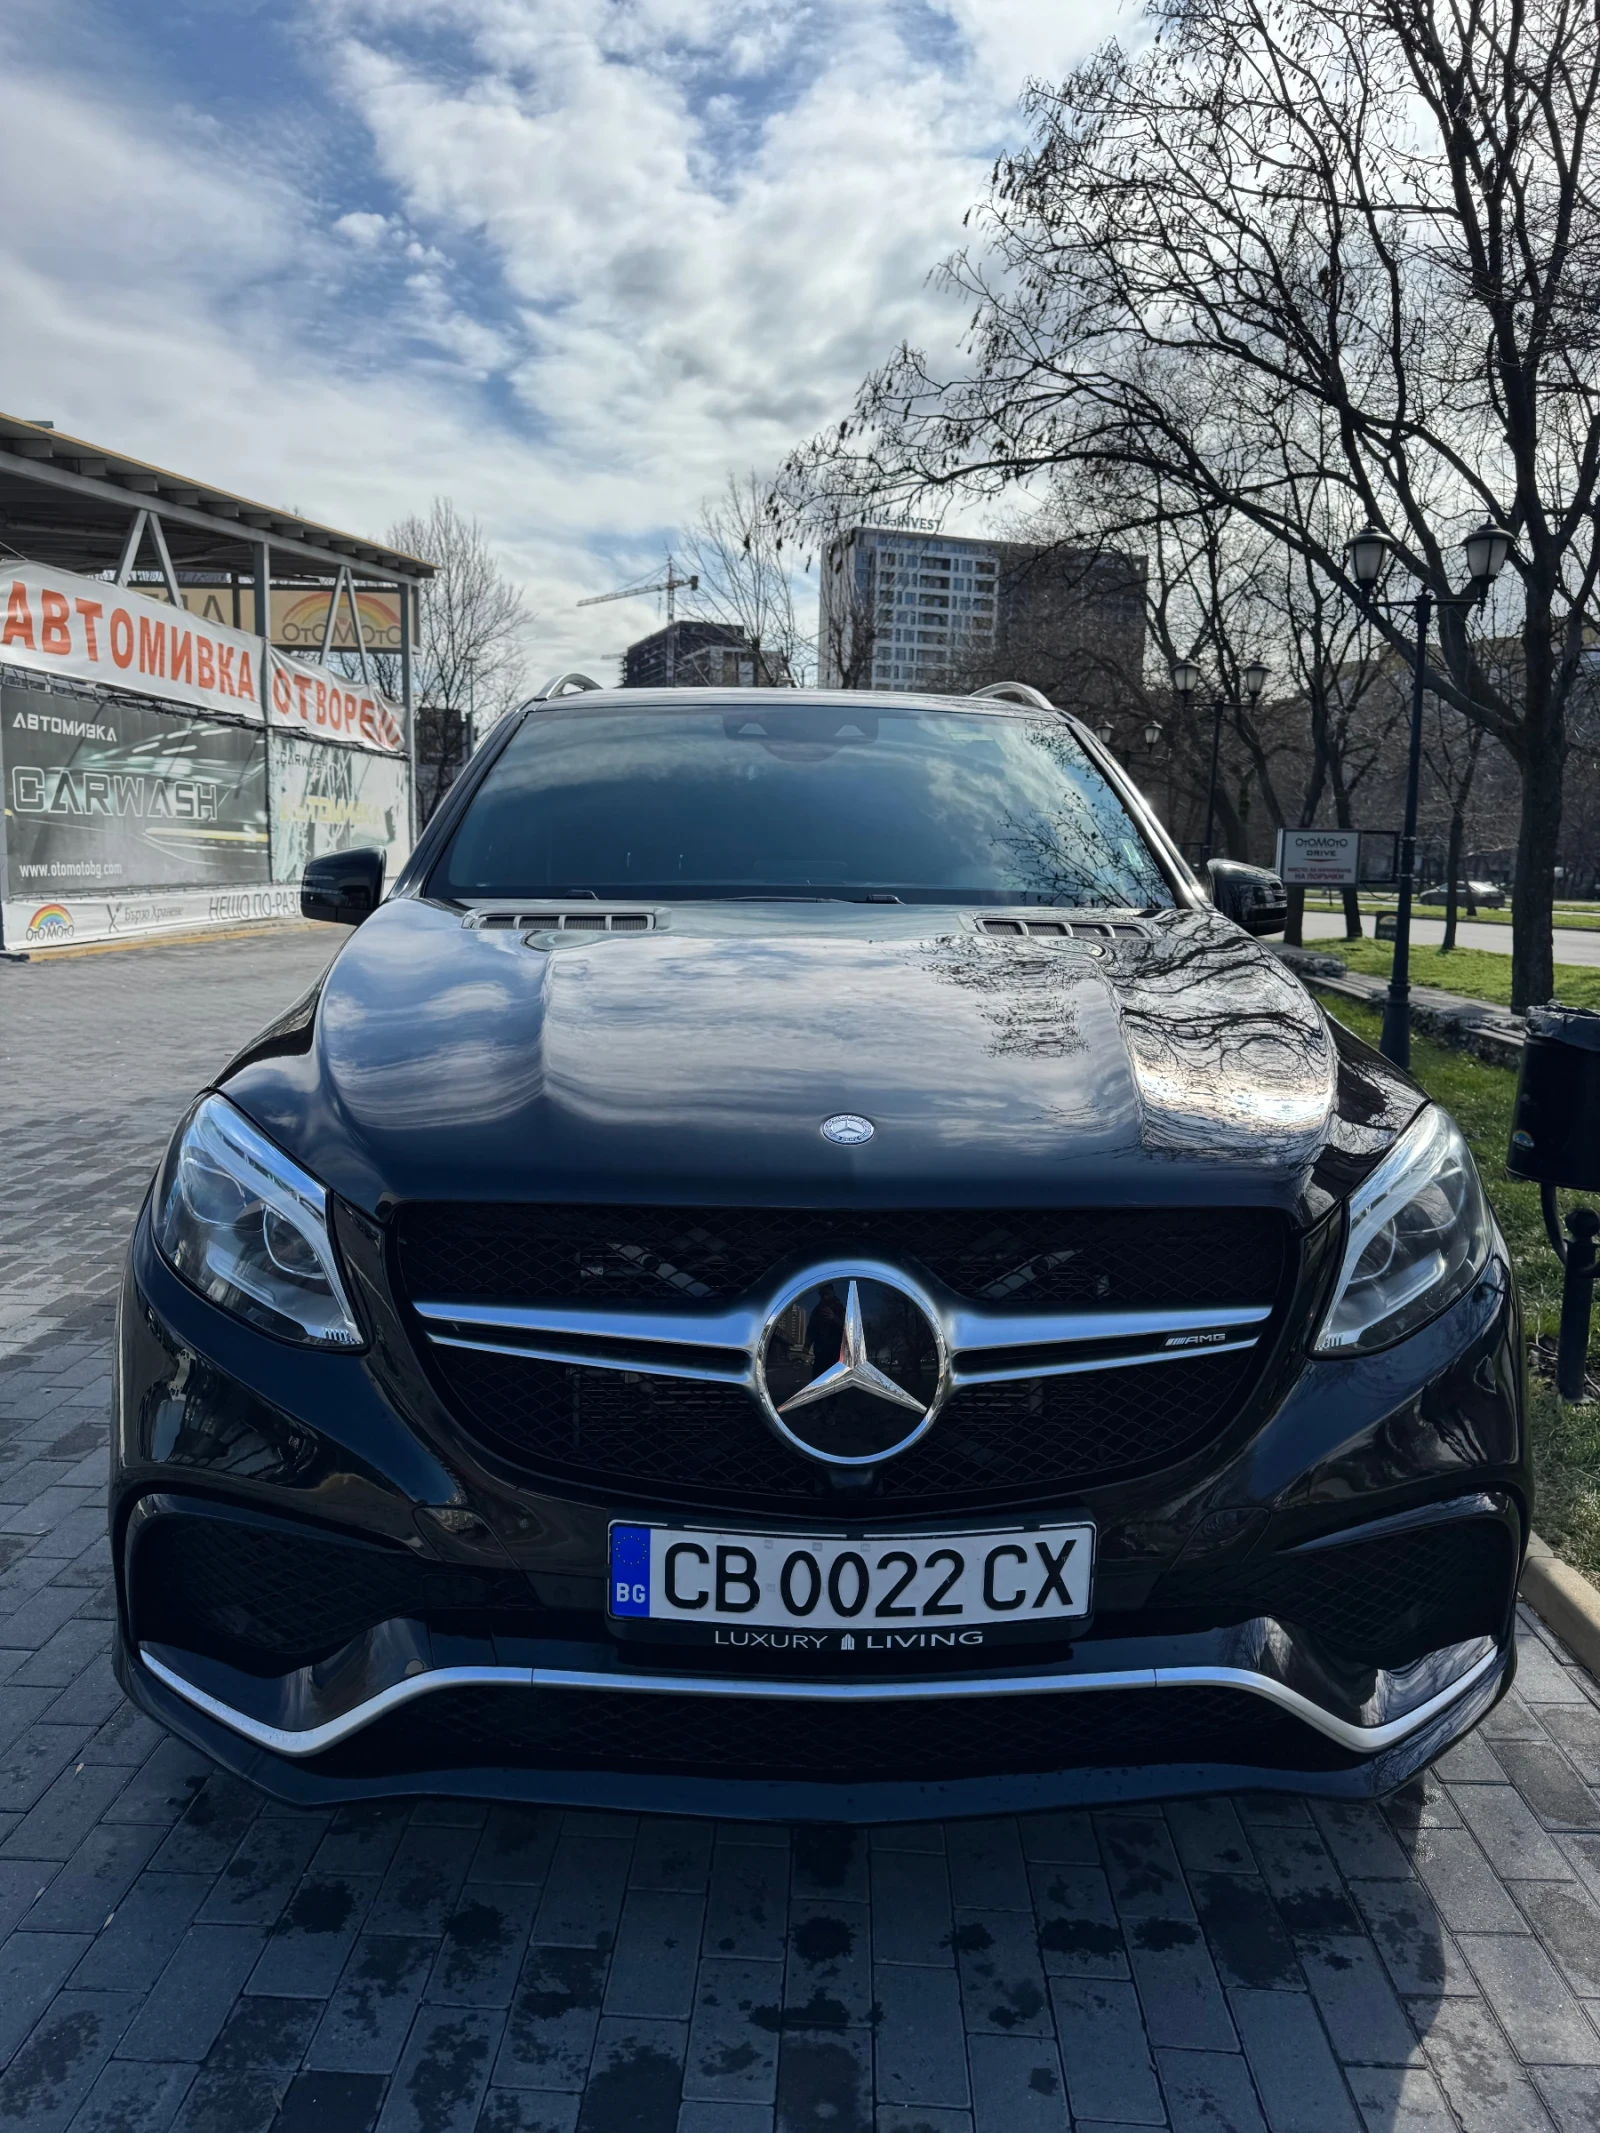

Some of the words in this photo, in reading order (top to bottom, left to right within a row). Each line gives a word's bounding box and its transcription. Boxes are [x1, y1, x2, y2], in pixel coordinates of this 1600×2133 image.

[1, 580, 257, 702] АВТОМИВКА
[12, 712, 117, 743] АВТОМИВКА
[12, 765, 218, 822] CARWASH
[1306, 849, 1337, 857] DRIVE
[19, 860, 123, 879] www.otomotobg.com
[1185, 1333, 1226, 1344] AMG
[664, 1541, 761, 1614] CB
[780, 1548, 965, 1618] 0022
[982, 1538, 1078, 1611] CX
[616, 1582, 646, 1604] BG
[715, 1629, 828, 1650] LUXURY
[867, 1630, 985, 1650] LIVING
